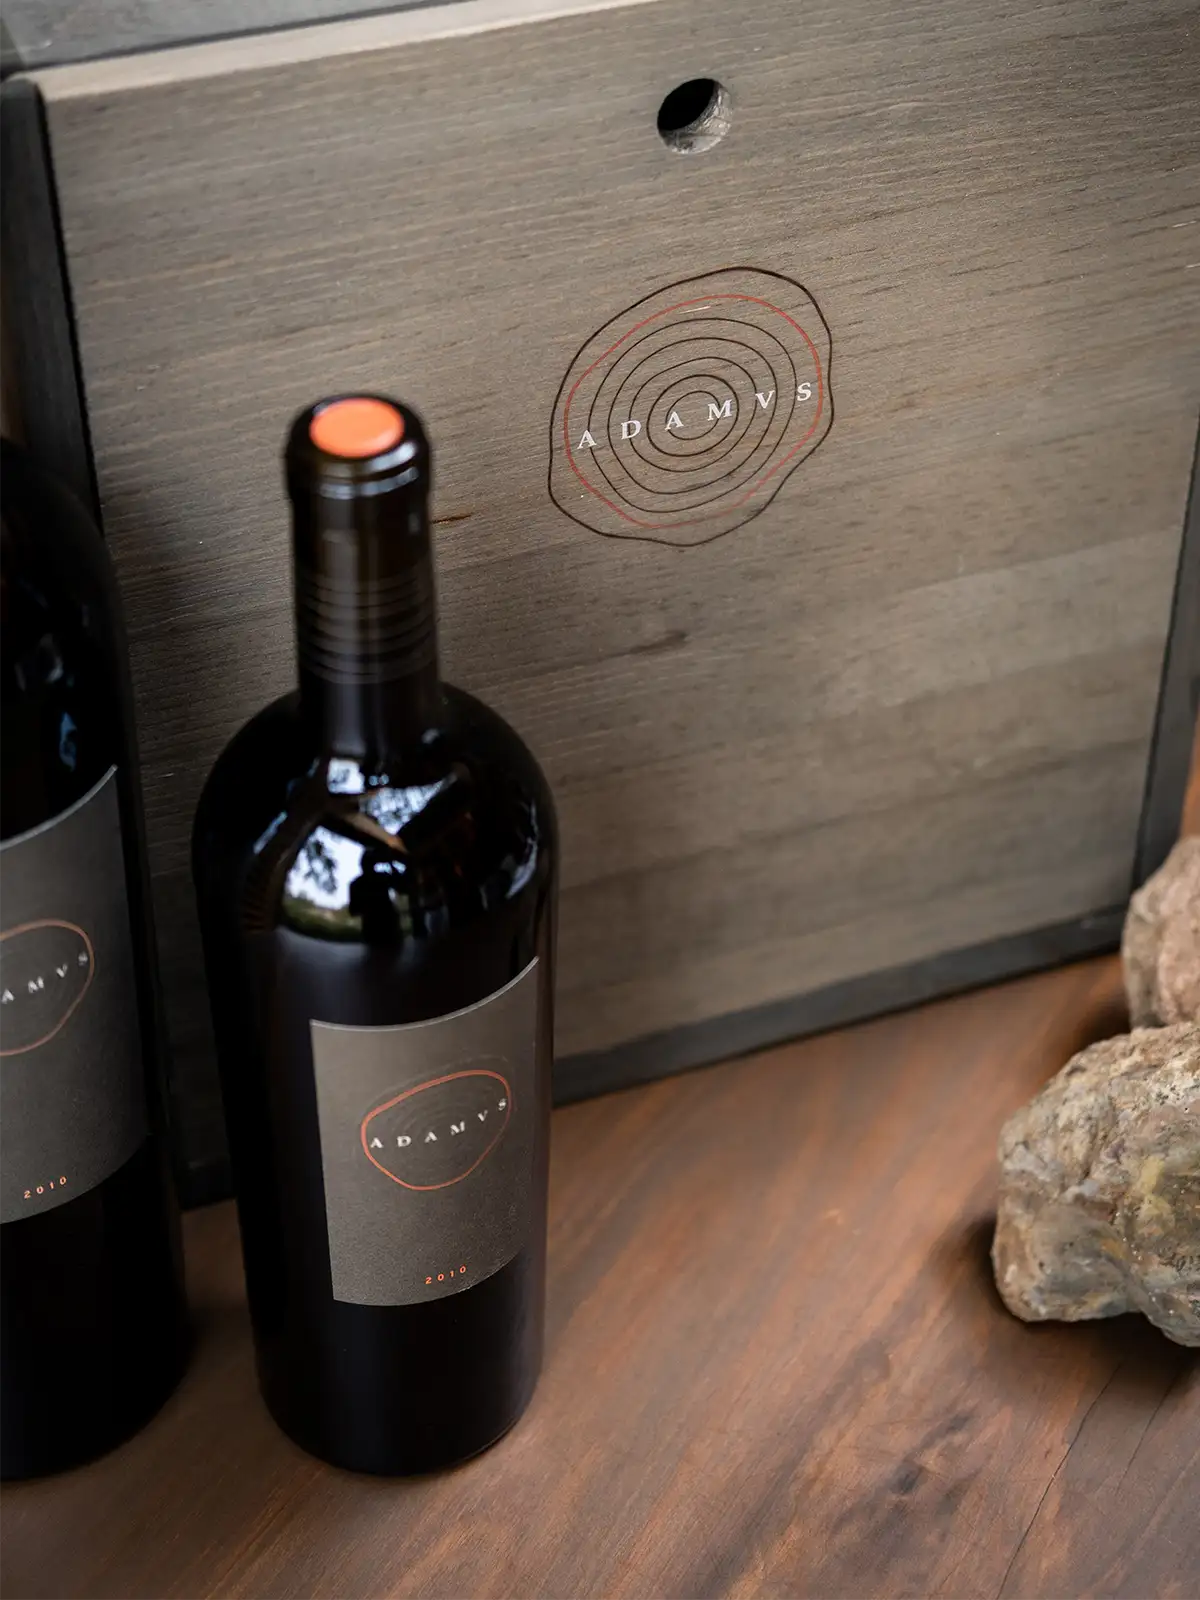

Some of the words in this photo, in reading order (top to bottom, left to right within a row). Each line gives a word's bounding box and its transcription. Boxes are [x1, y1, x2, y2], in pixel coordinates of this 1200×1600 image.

[577, 382, 812, 449] ADAMVS
[370, 1098, 507, 1149] ADAMVS
[23, 1176, 67, 1199] 2010
[425, 1265, 467, 1285] 2010
